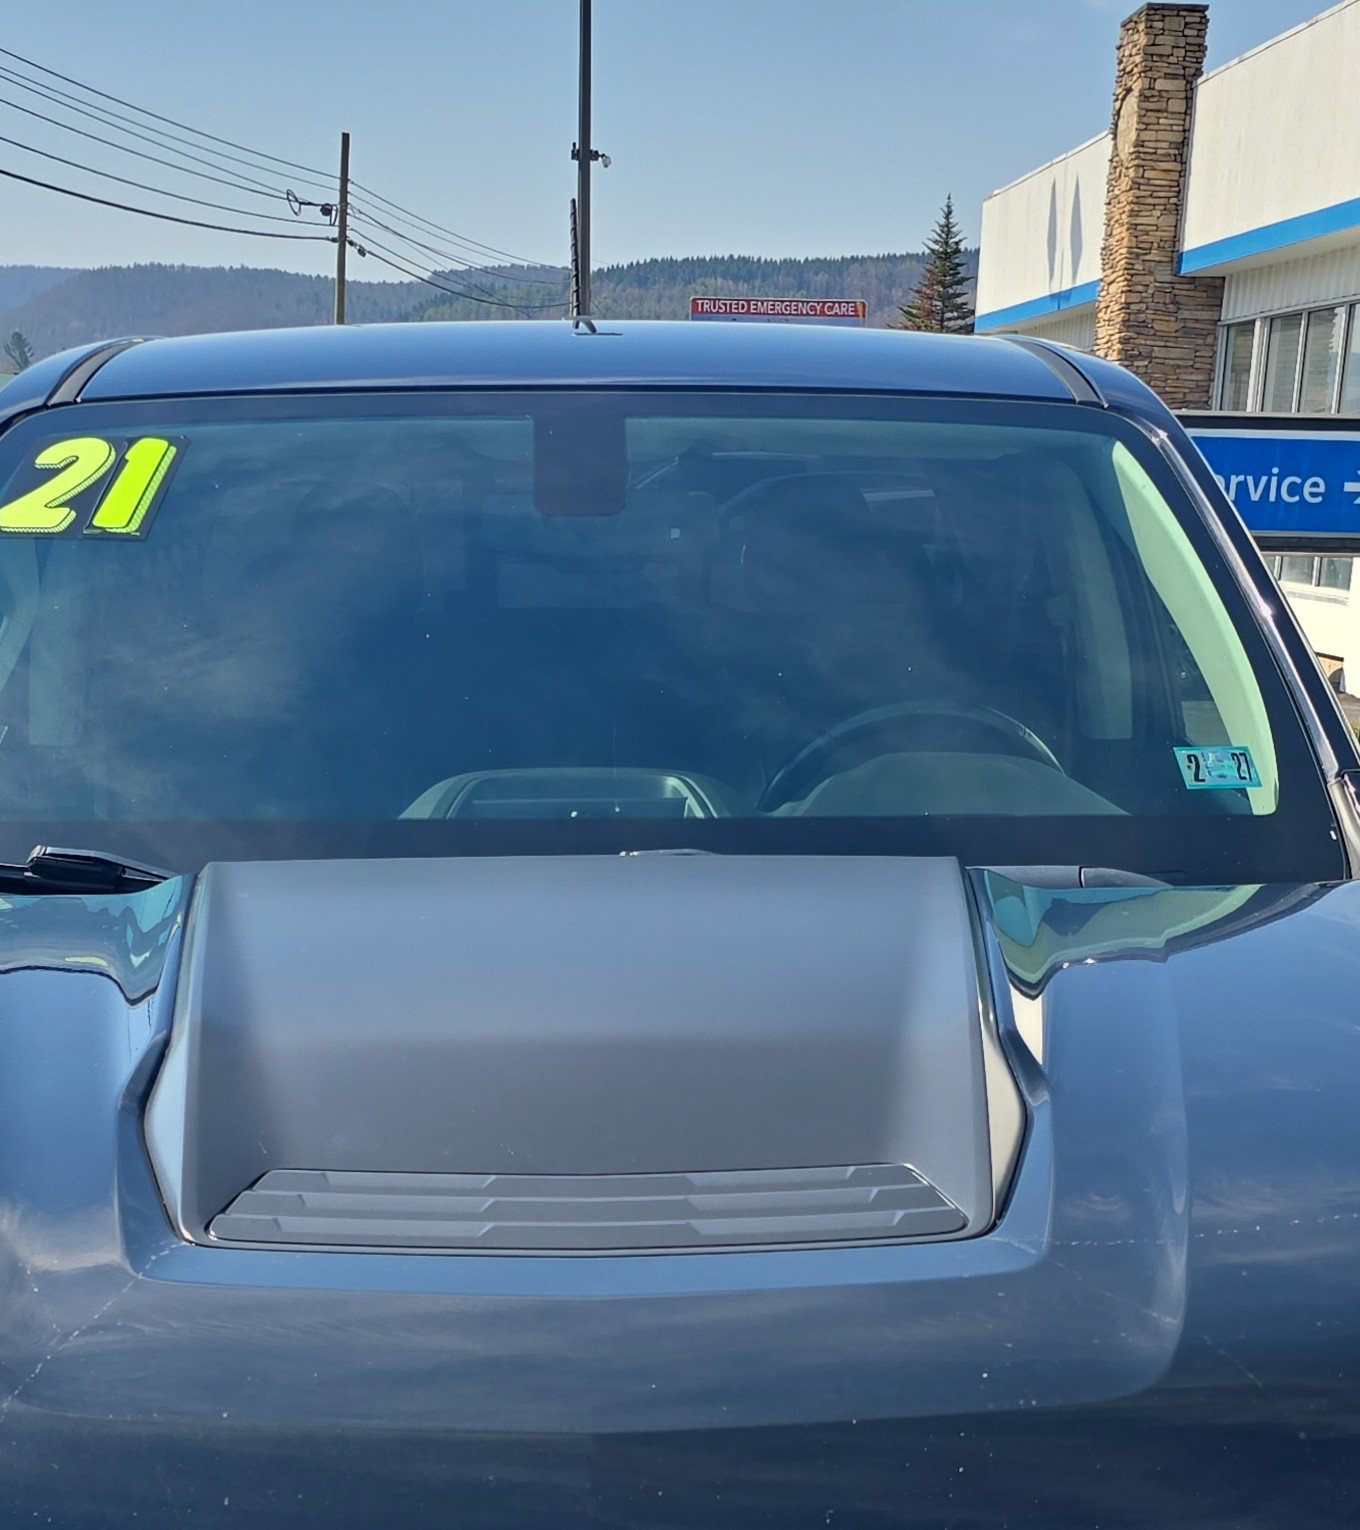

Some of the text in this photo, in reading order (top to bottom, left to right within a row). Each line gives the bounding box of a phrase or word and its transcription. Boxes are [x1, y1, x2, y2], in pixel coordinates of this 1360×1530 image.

[696, 299, 855, 316] TRUSTED EMERGENCY CARE
[1214, 466, 1326, 504] rvice
[1230, 752, 1253, 782] 27
